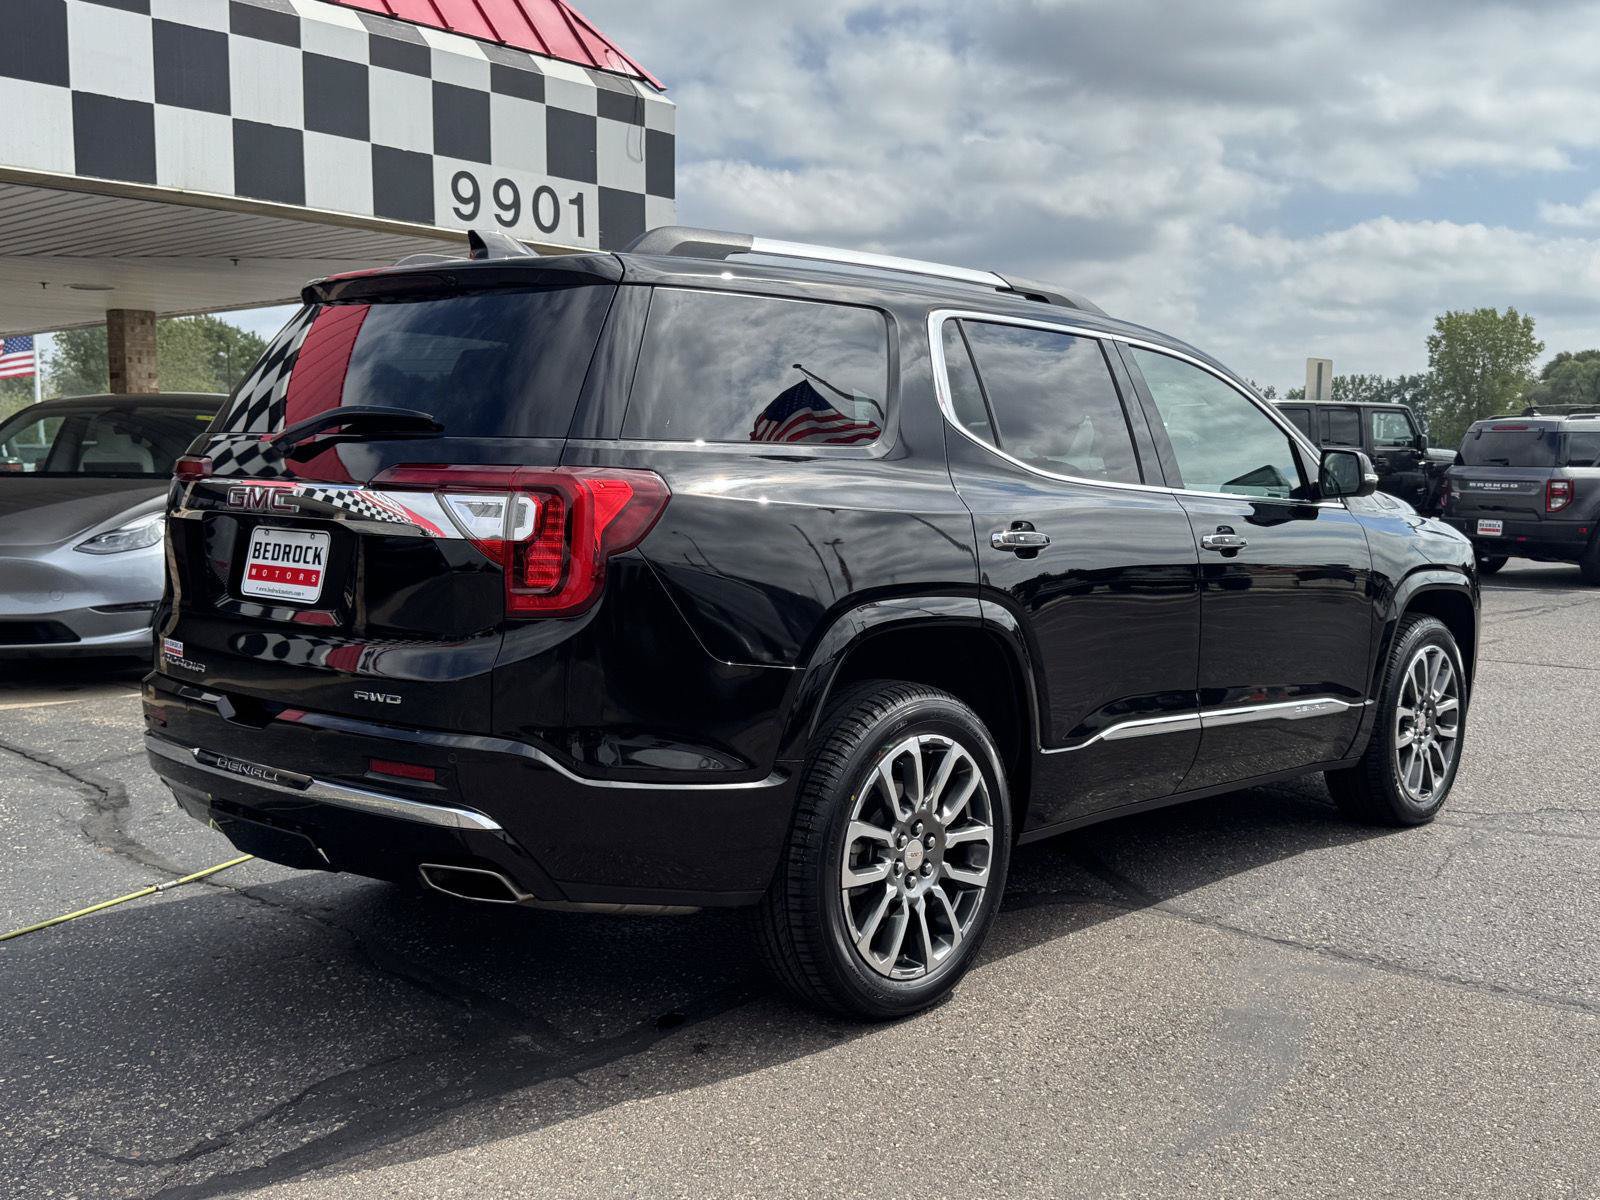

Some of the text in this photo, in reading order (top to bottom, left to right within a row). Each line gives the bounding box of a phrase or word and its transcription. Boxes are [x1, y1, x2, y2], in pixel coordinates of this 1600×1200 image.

[451, 170, 585, 238] 9901
[227, 486, 300, 513] GMC
[252, 541, 324, 565] BEDROCK
[251, 568, 317, 583] MOTORS
[353, 690, 402, 704] AWD
[216, 757, 278, 782] DENALI
